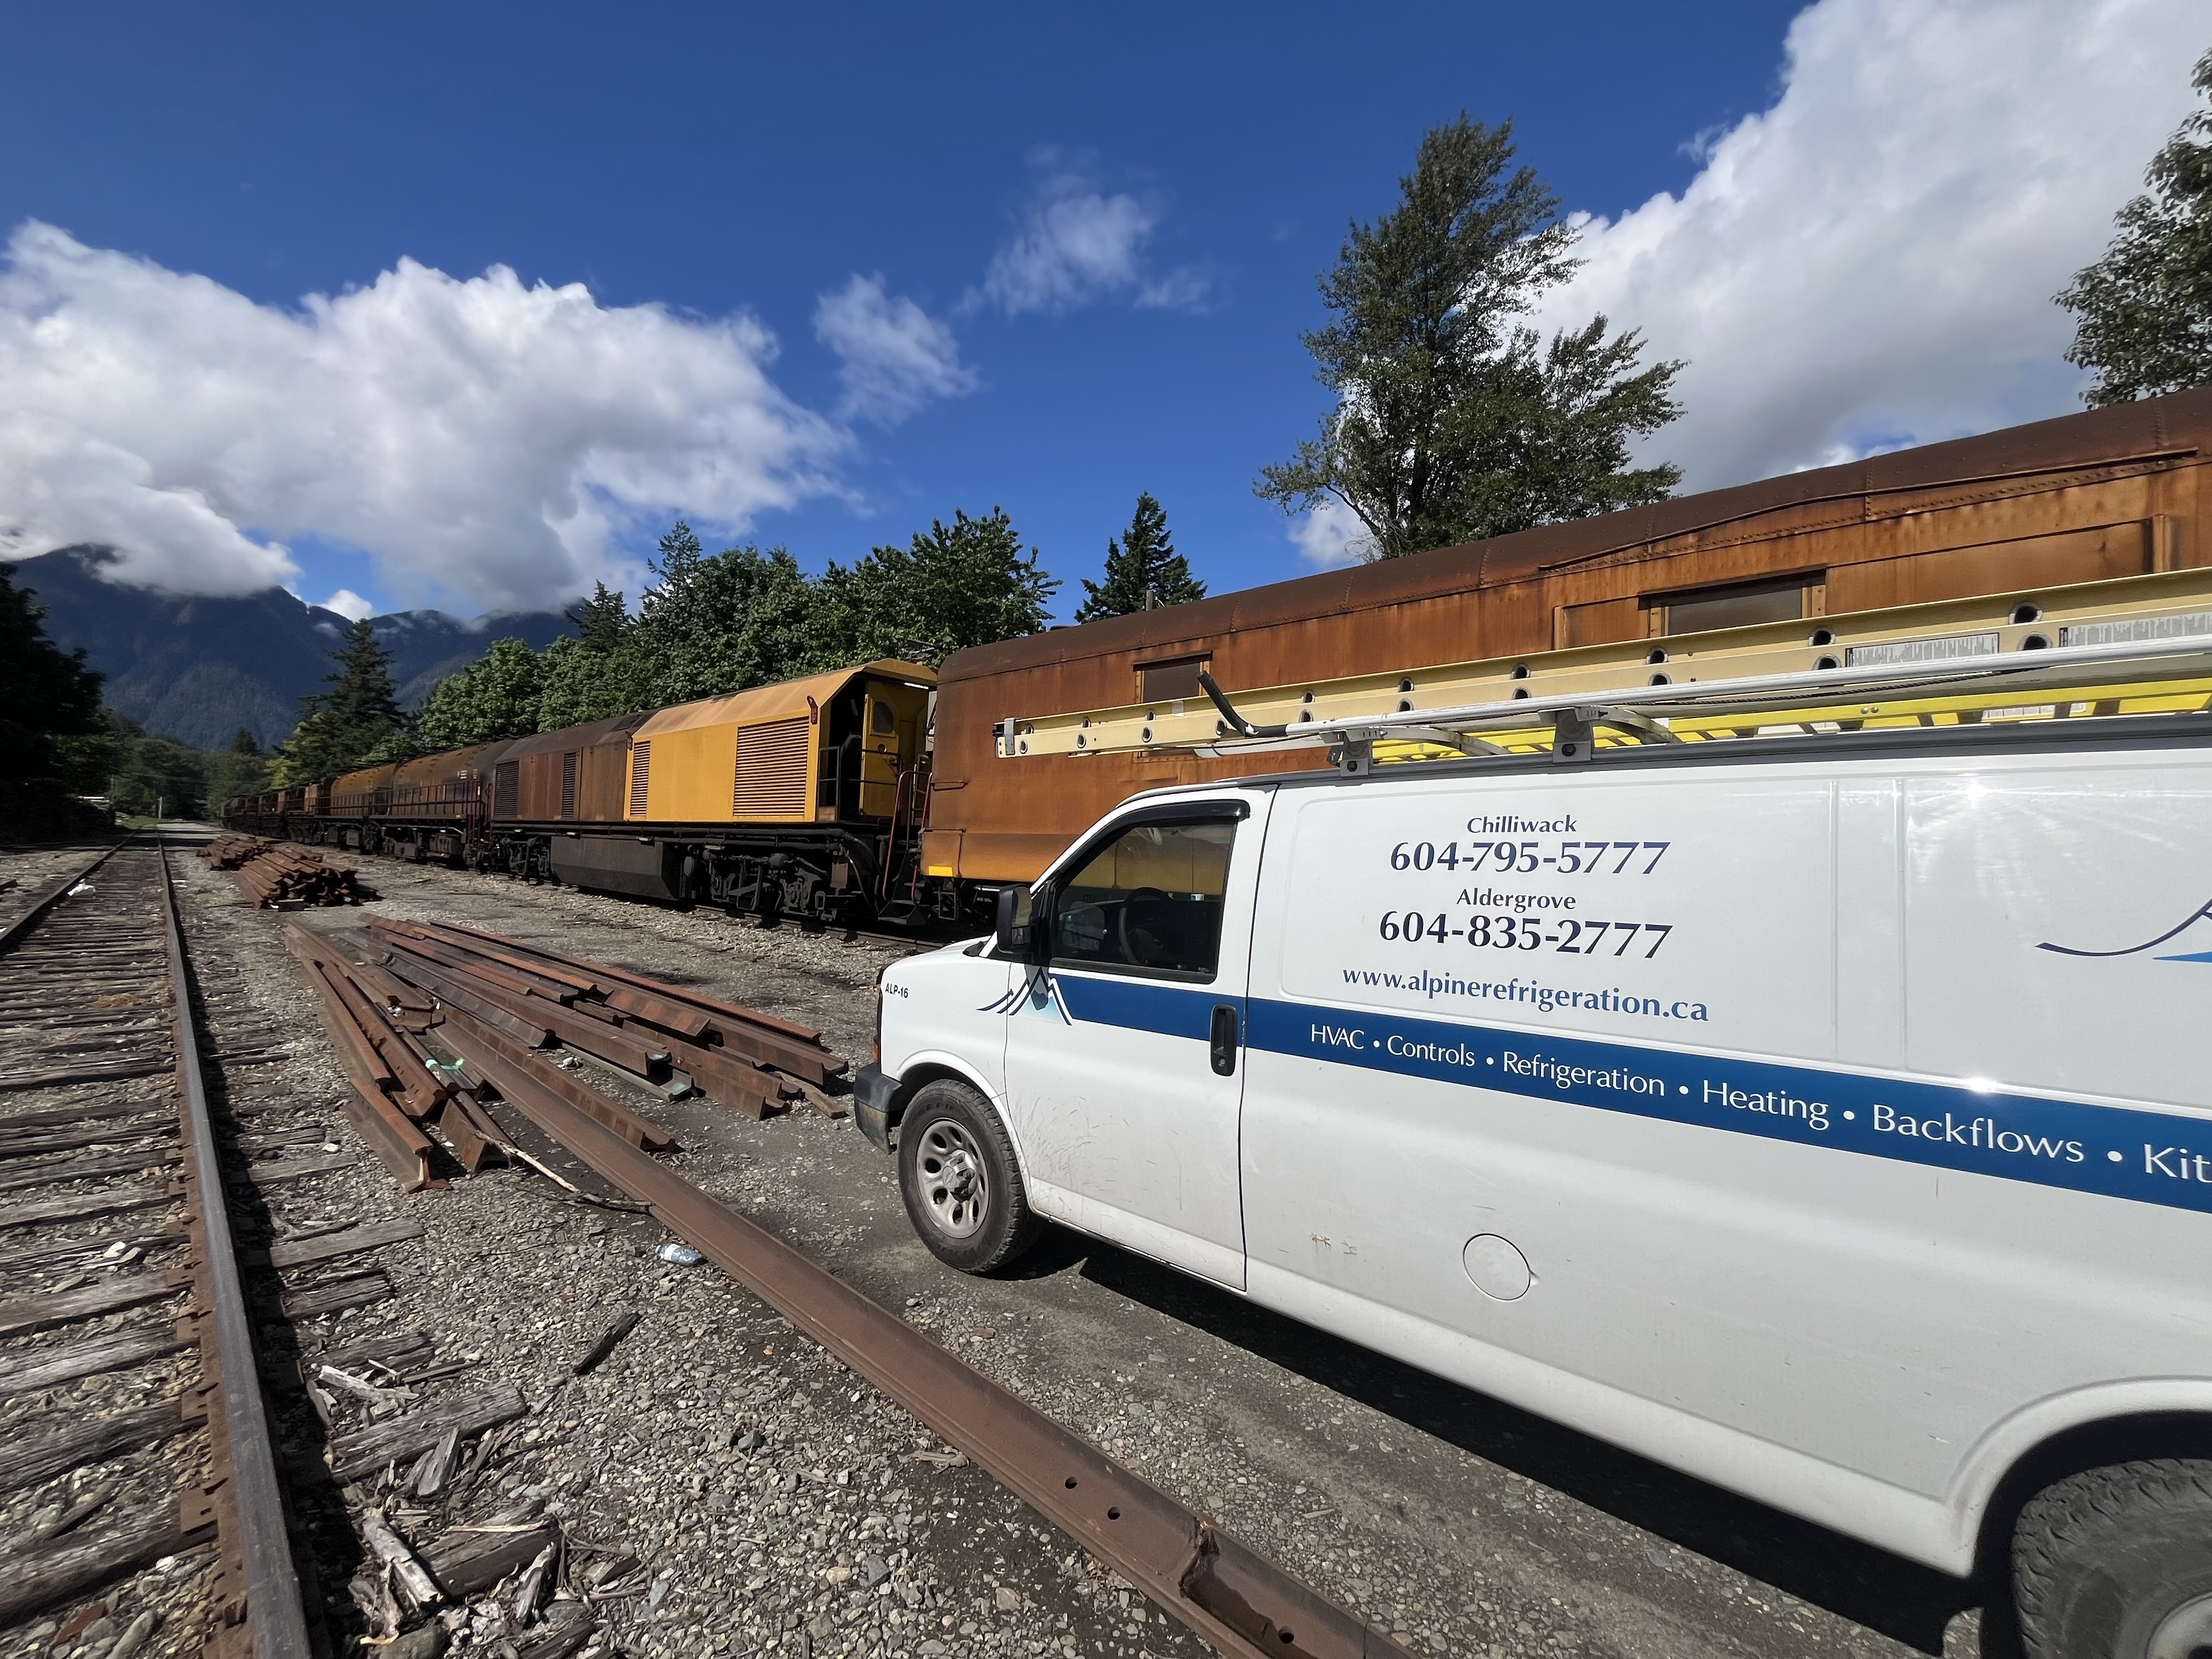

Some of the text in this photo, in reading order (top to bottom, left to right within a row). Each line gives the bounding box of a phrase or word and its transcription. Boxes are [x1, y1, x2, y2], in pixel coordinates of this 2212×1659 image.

[1468, 815, 1577, 833] Chilliwack
[1391, 842, 1671, 874] 604-795-5777
[1457, 888, 1576, 913] Aldergrove
[1380, 910, 1673, 959] 604-835-2777
[885, 983, 909, 998] ALP-16
[1342, 969, 1708, 1022] www.alpinerefrigeration.ca
[1312, 1024, 2212, 1182] HVAC Controls Refrigeration Heating Backflows Kit
